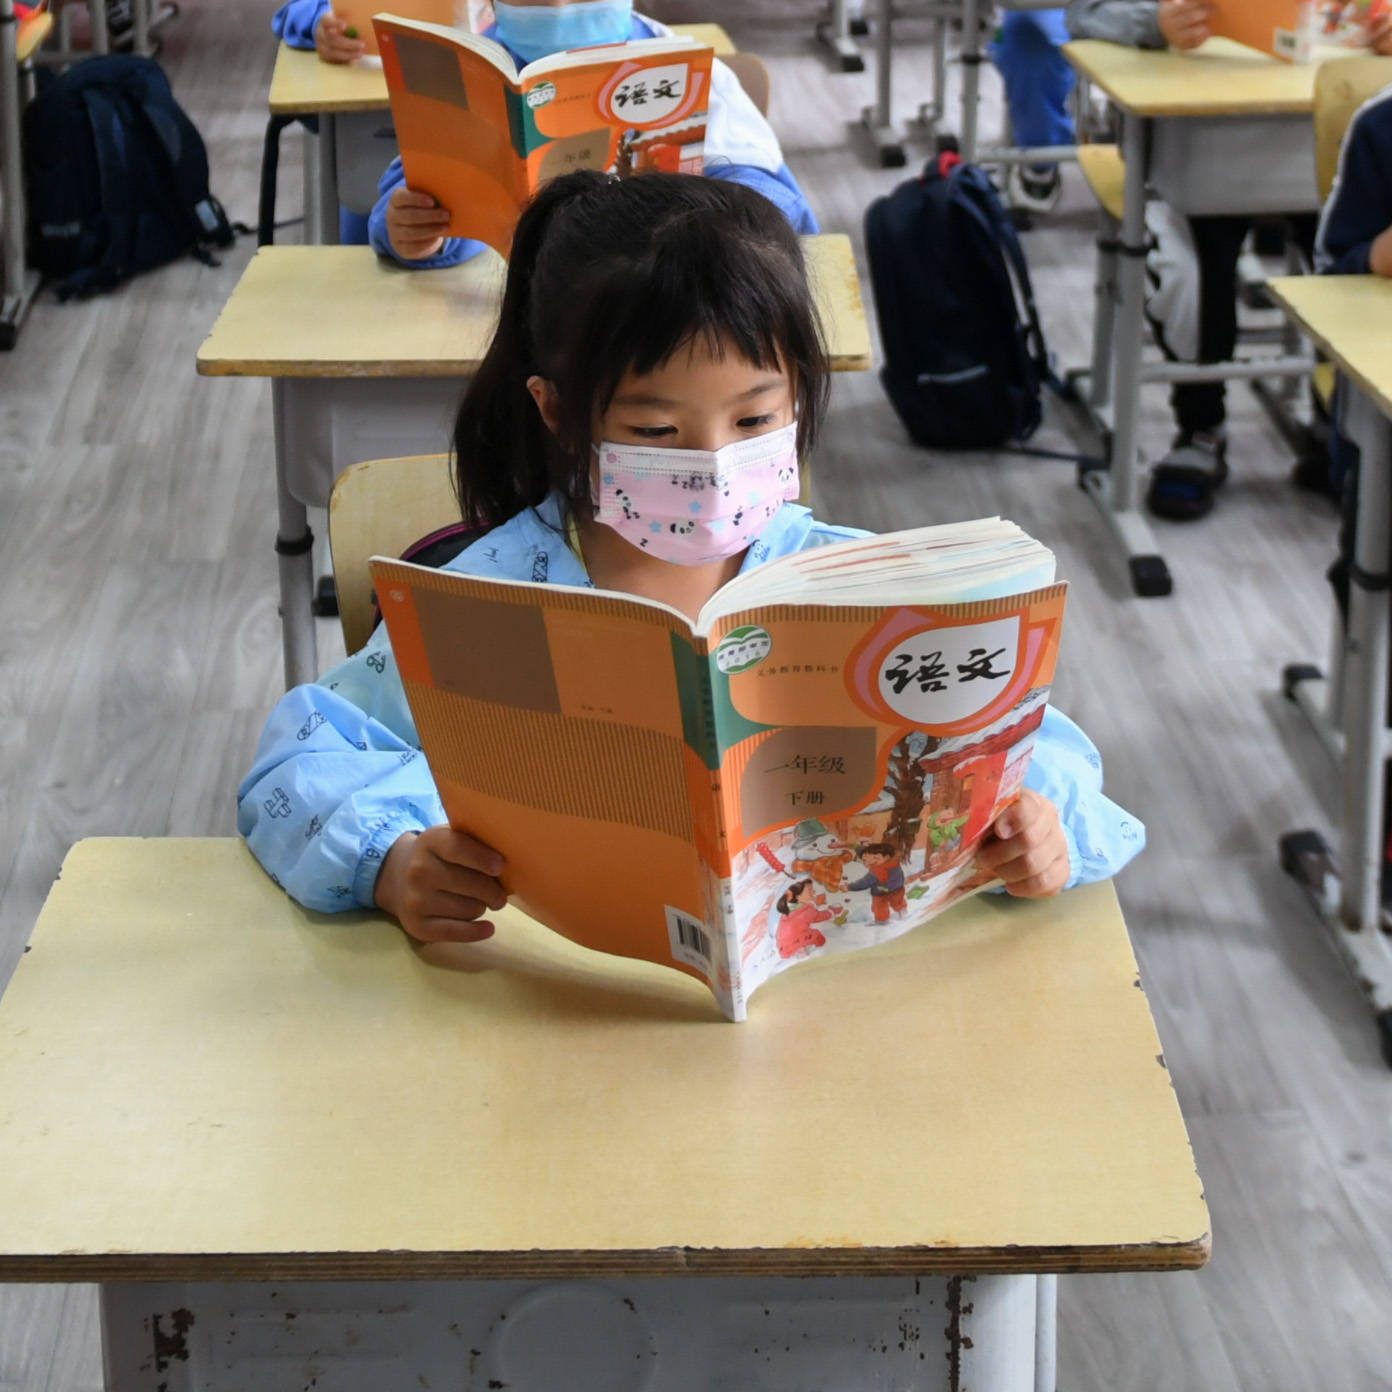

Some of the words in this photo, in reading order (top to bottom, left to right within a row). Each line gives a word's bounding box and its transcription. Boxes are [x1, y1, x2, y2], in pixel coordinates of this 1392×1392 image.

[615, 80, 681, 107] 语文
[884, 646, 1012, 695] 语文
[763, 753, 847, 778] 一年级
[785, 790, 825, 807] 下册
